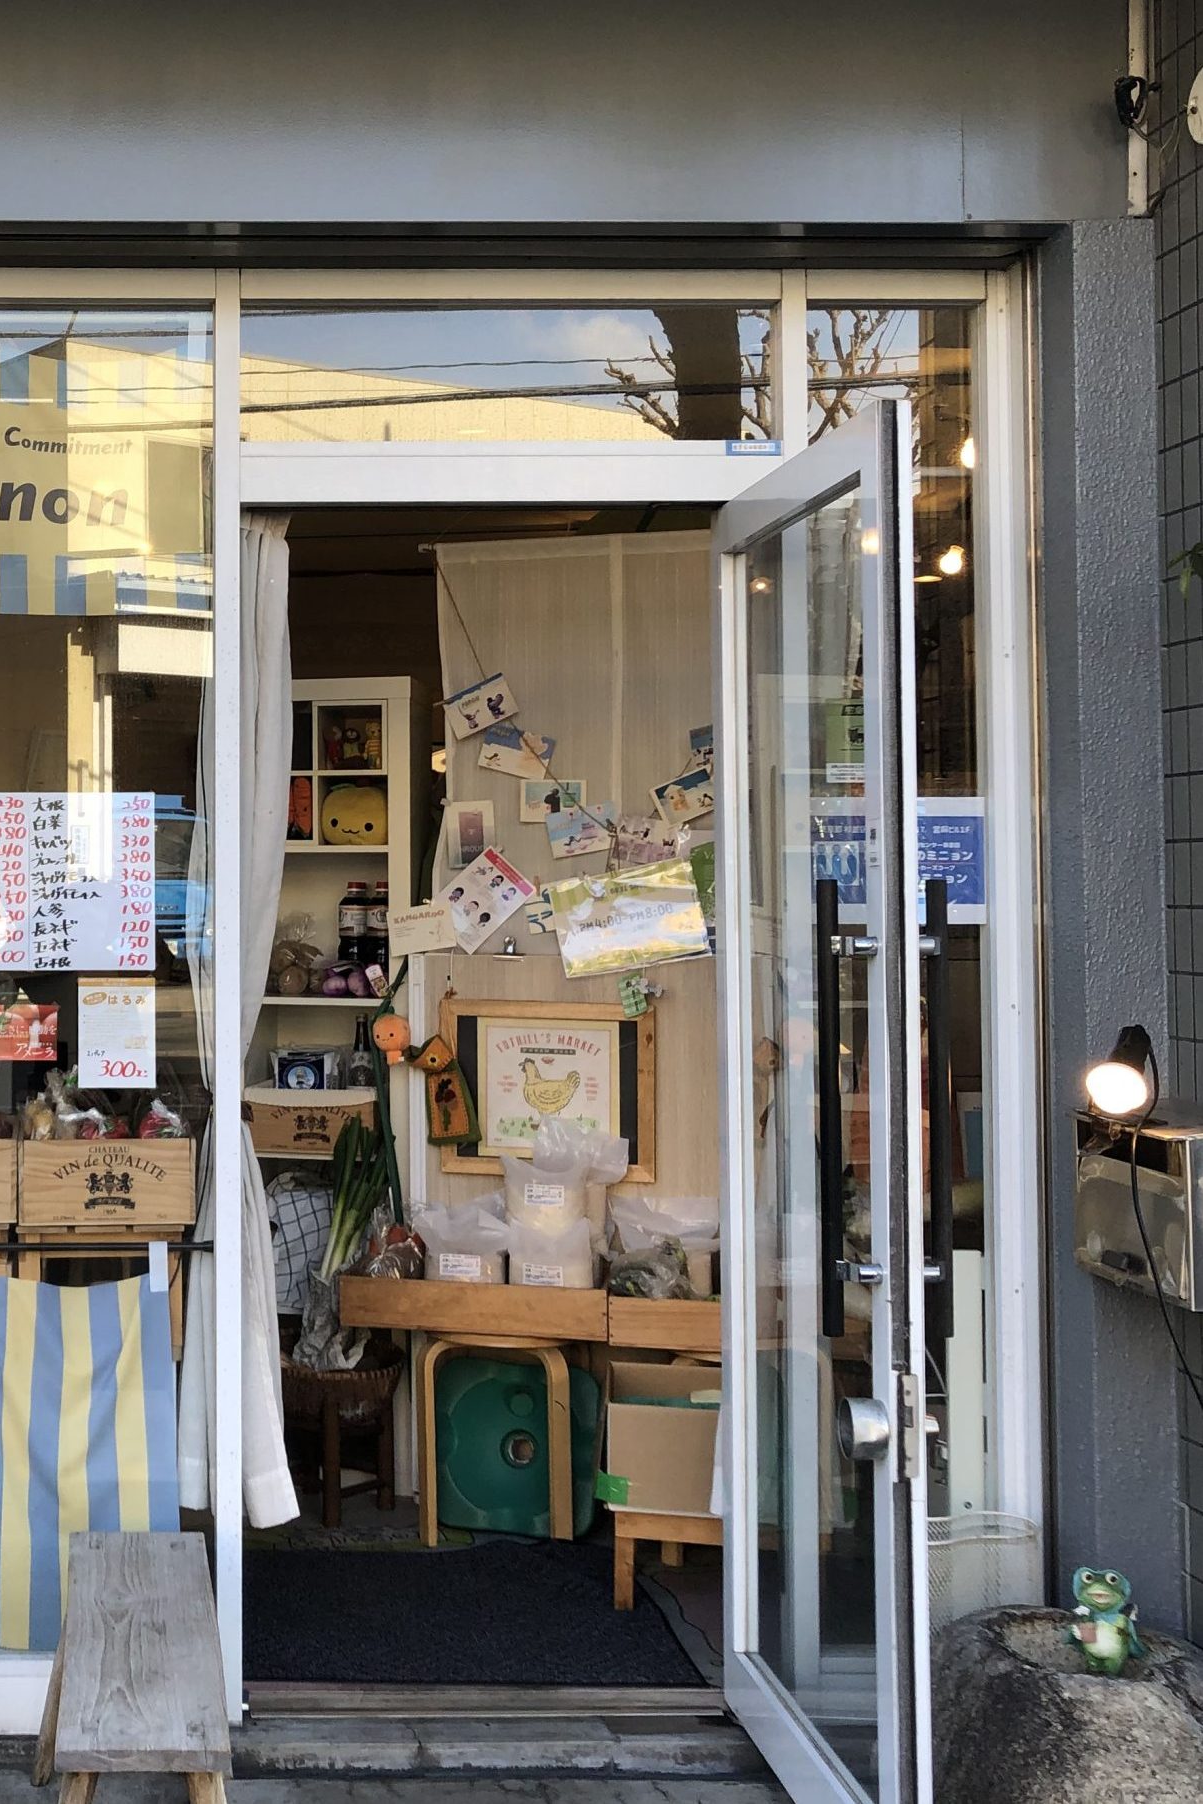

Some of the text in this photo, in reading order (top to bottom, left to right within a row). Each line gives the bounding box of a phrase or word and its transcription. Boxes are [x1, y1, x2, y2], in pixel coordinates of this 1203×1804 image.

[4, 426, 133, 455] Commitment
[30, 795, 150, 812] 大根 250
[33, 813, 62, 831] 白菜
[30, 835, 73, 850] キャベツ
[120, 834, 150, 848] 330
[117, 849, 151, 864] 280
[121, 868, 151, 882] 350
[119, 884, 152, 899] 380
[32, 901, 153, 919] 人参 180
[31, 919, 151, 937] 長ネギ 120
[120, 935, 149, 949] 150
[119, 952, 148, 967] 150
[107, 995, 147, 1006] はるみ
[14, 1042, 55, 1059] アメーラ
[97, 1059, 137, 1078] 300
[88, 1145, 130, 1153] CHATEAU
[52, 1153, 168, 1182] VIN de QUALITE
